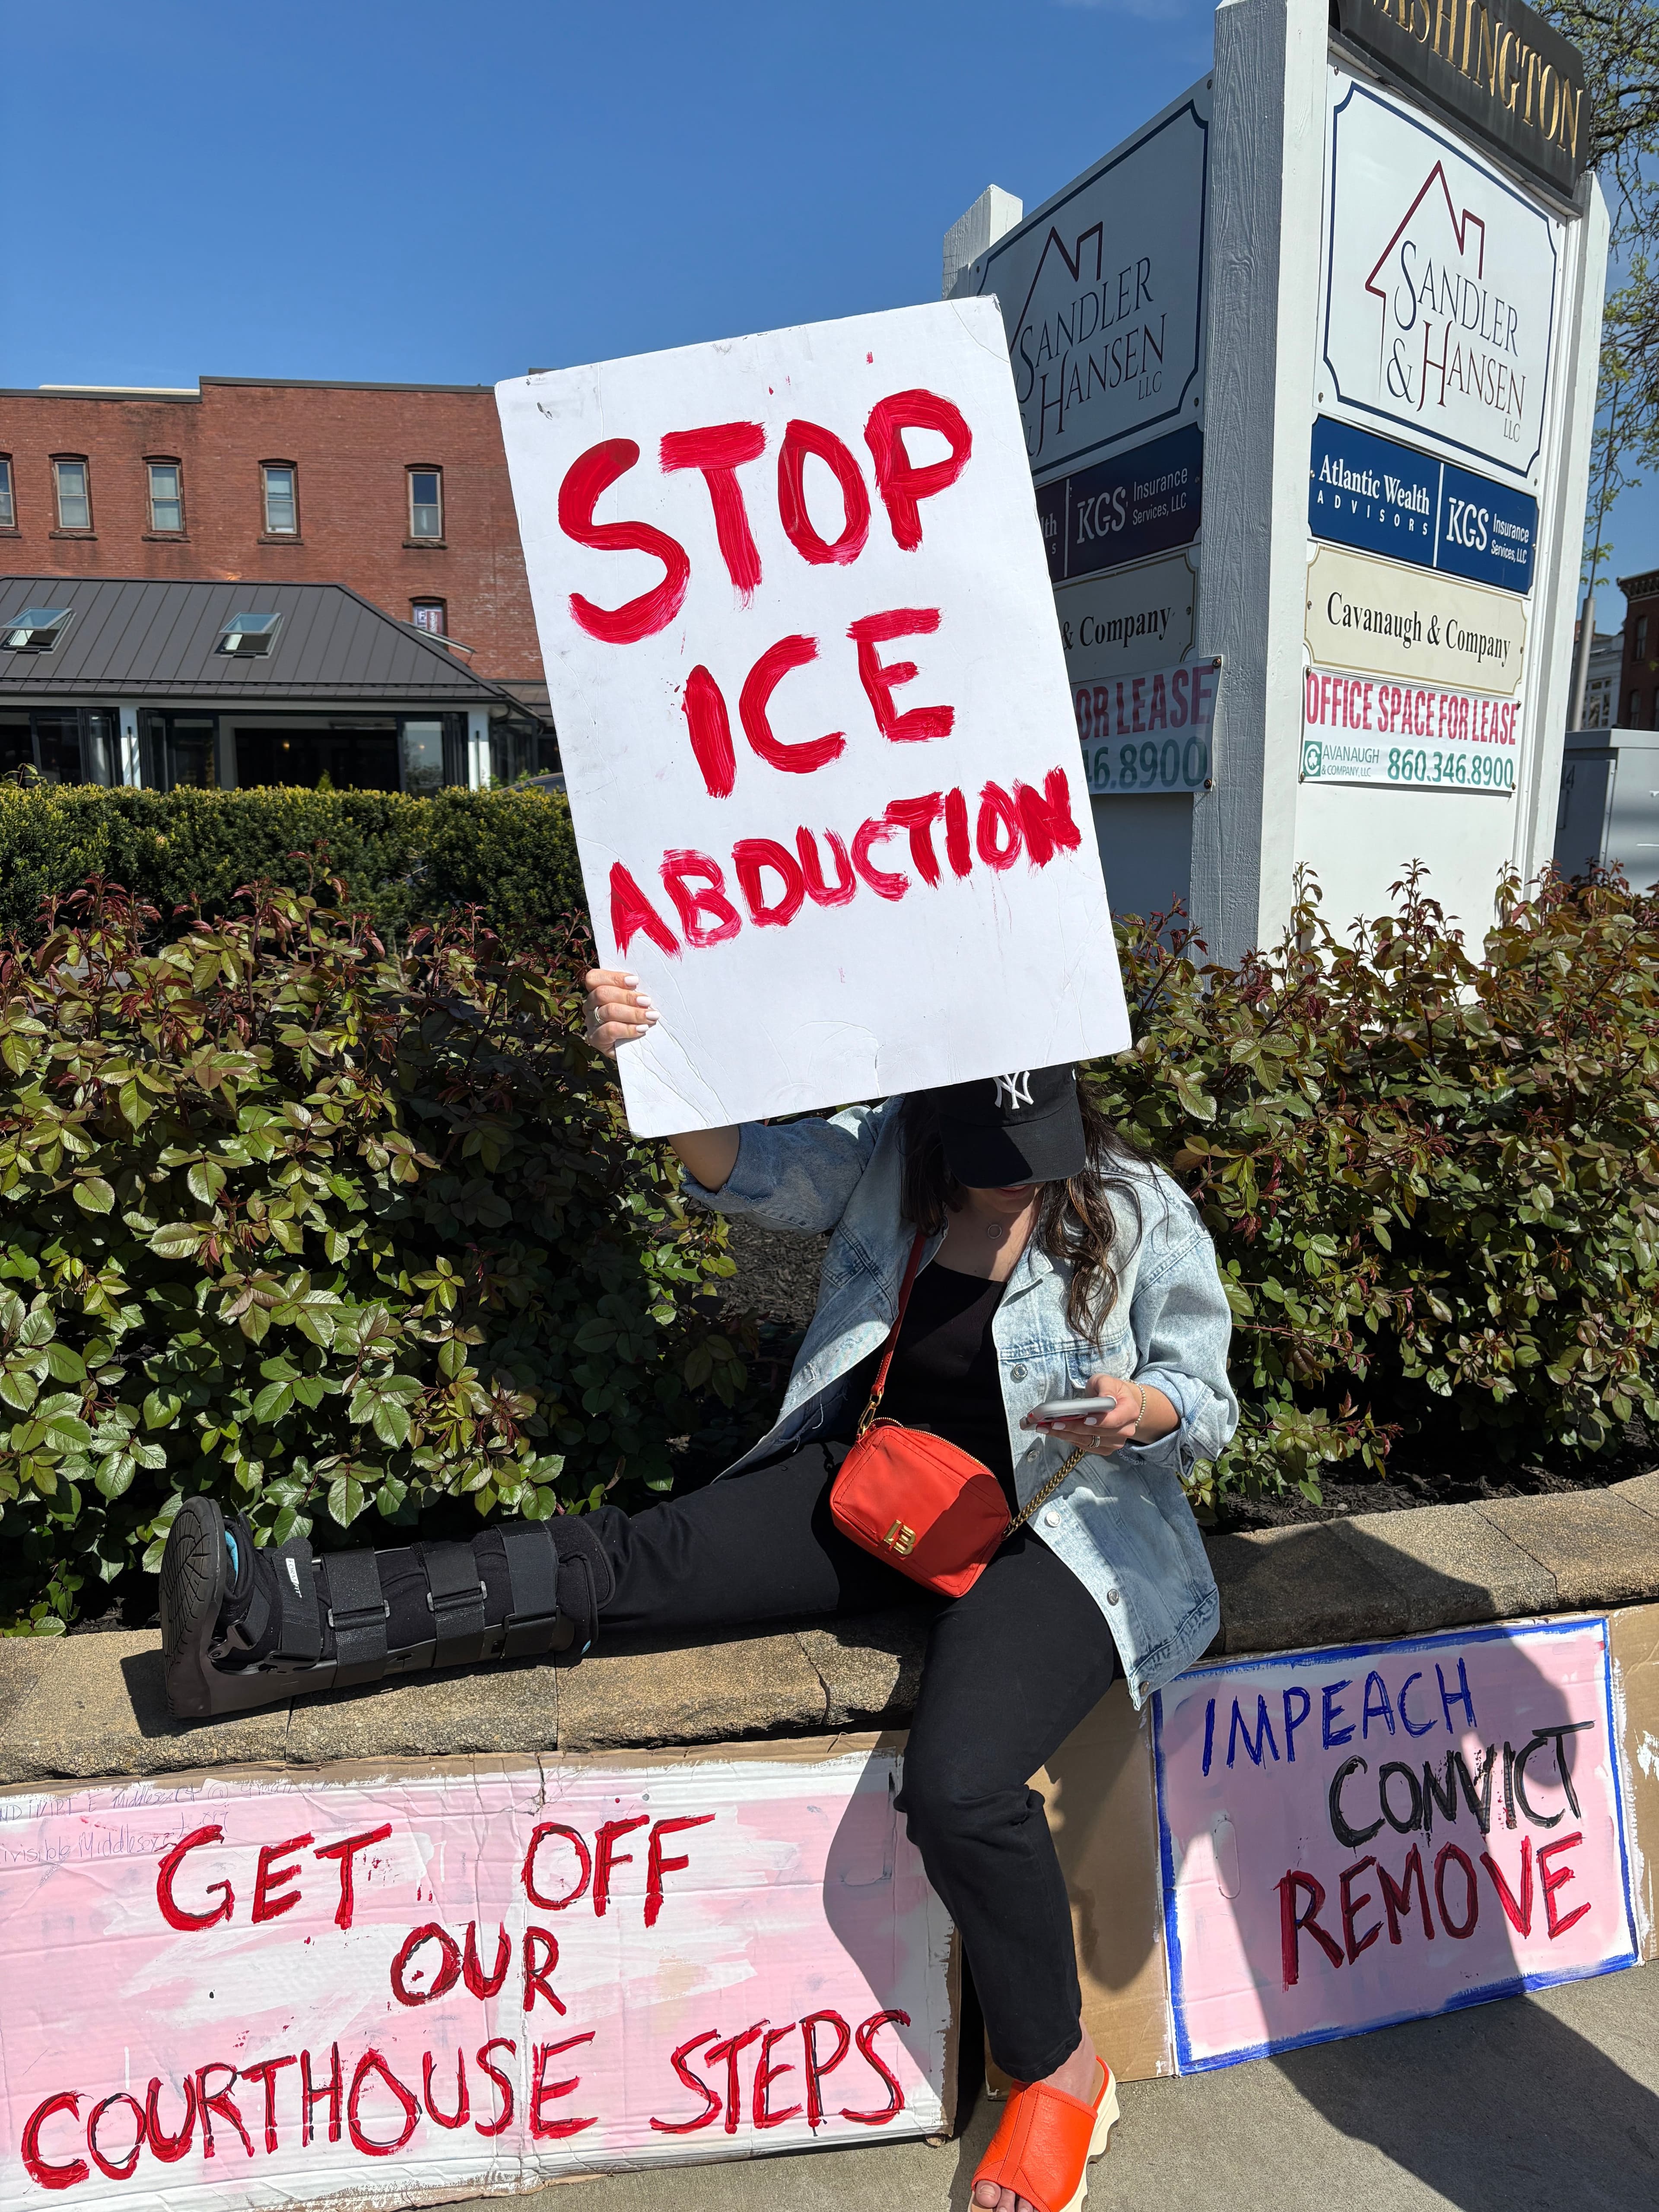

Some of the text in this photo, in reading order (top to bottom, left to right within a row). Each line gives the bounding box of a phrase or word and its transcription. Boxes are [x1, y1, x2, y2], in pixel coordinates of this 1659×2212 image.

[1373, 0, 1583, 158] SHINGTON
[1017, 257, 1154, 404] SANDLER
[1394, 240, 1518, 357] SANDLER
[1036, 313, 1167, 458] HANSEN
[1138, 370, 1162, 400] LLC
[1386, 320, 1526, 420] & HANSEN
[1503, 418, 1521, 443] LLC
[558, 388, 973, 645] STOP
[1076, 486, 1126, 544] KGS
[1132, 492, 1187, 526] Services, LLC
[1133, 467, 1188, 502] Insurance
[1317, 489, 1428, 536] ADVISORS
[1319, 454, 1430, 516] Atlantic Wealth
[1446, 496, 1489, 551] KGS
[1491, 539, 1527, 564] Services, LLC
[1493, 513, 1529, 543] Insurance
[1080, 607, 1172, 648] Company
[1327, 591, 1511, 667] Cavanaugh & Company
[680, 607, 956, 800] ICE
[1075, 665, 1214, 741] OR LEASE
[1306, 672, 1518, 745] OFFICE SPACE FOR LEASE
[1387, 747, 1514, 789] 860.346.8900
[610, 766, 1082, 960] ABDUCTION
[1203, 1657, 1478, 1777] IMPEACH
[1329, 1720, 1595, 1850] CONVICT
[157, 1812, 715, 1932] GET OFF
[1273, 1831, 1592, 1991] REMOVE
[390, 1921, 566, 2015] OUR
[21, 2009, 911, 2190] COURTHOUSE STEPS
